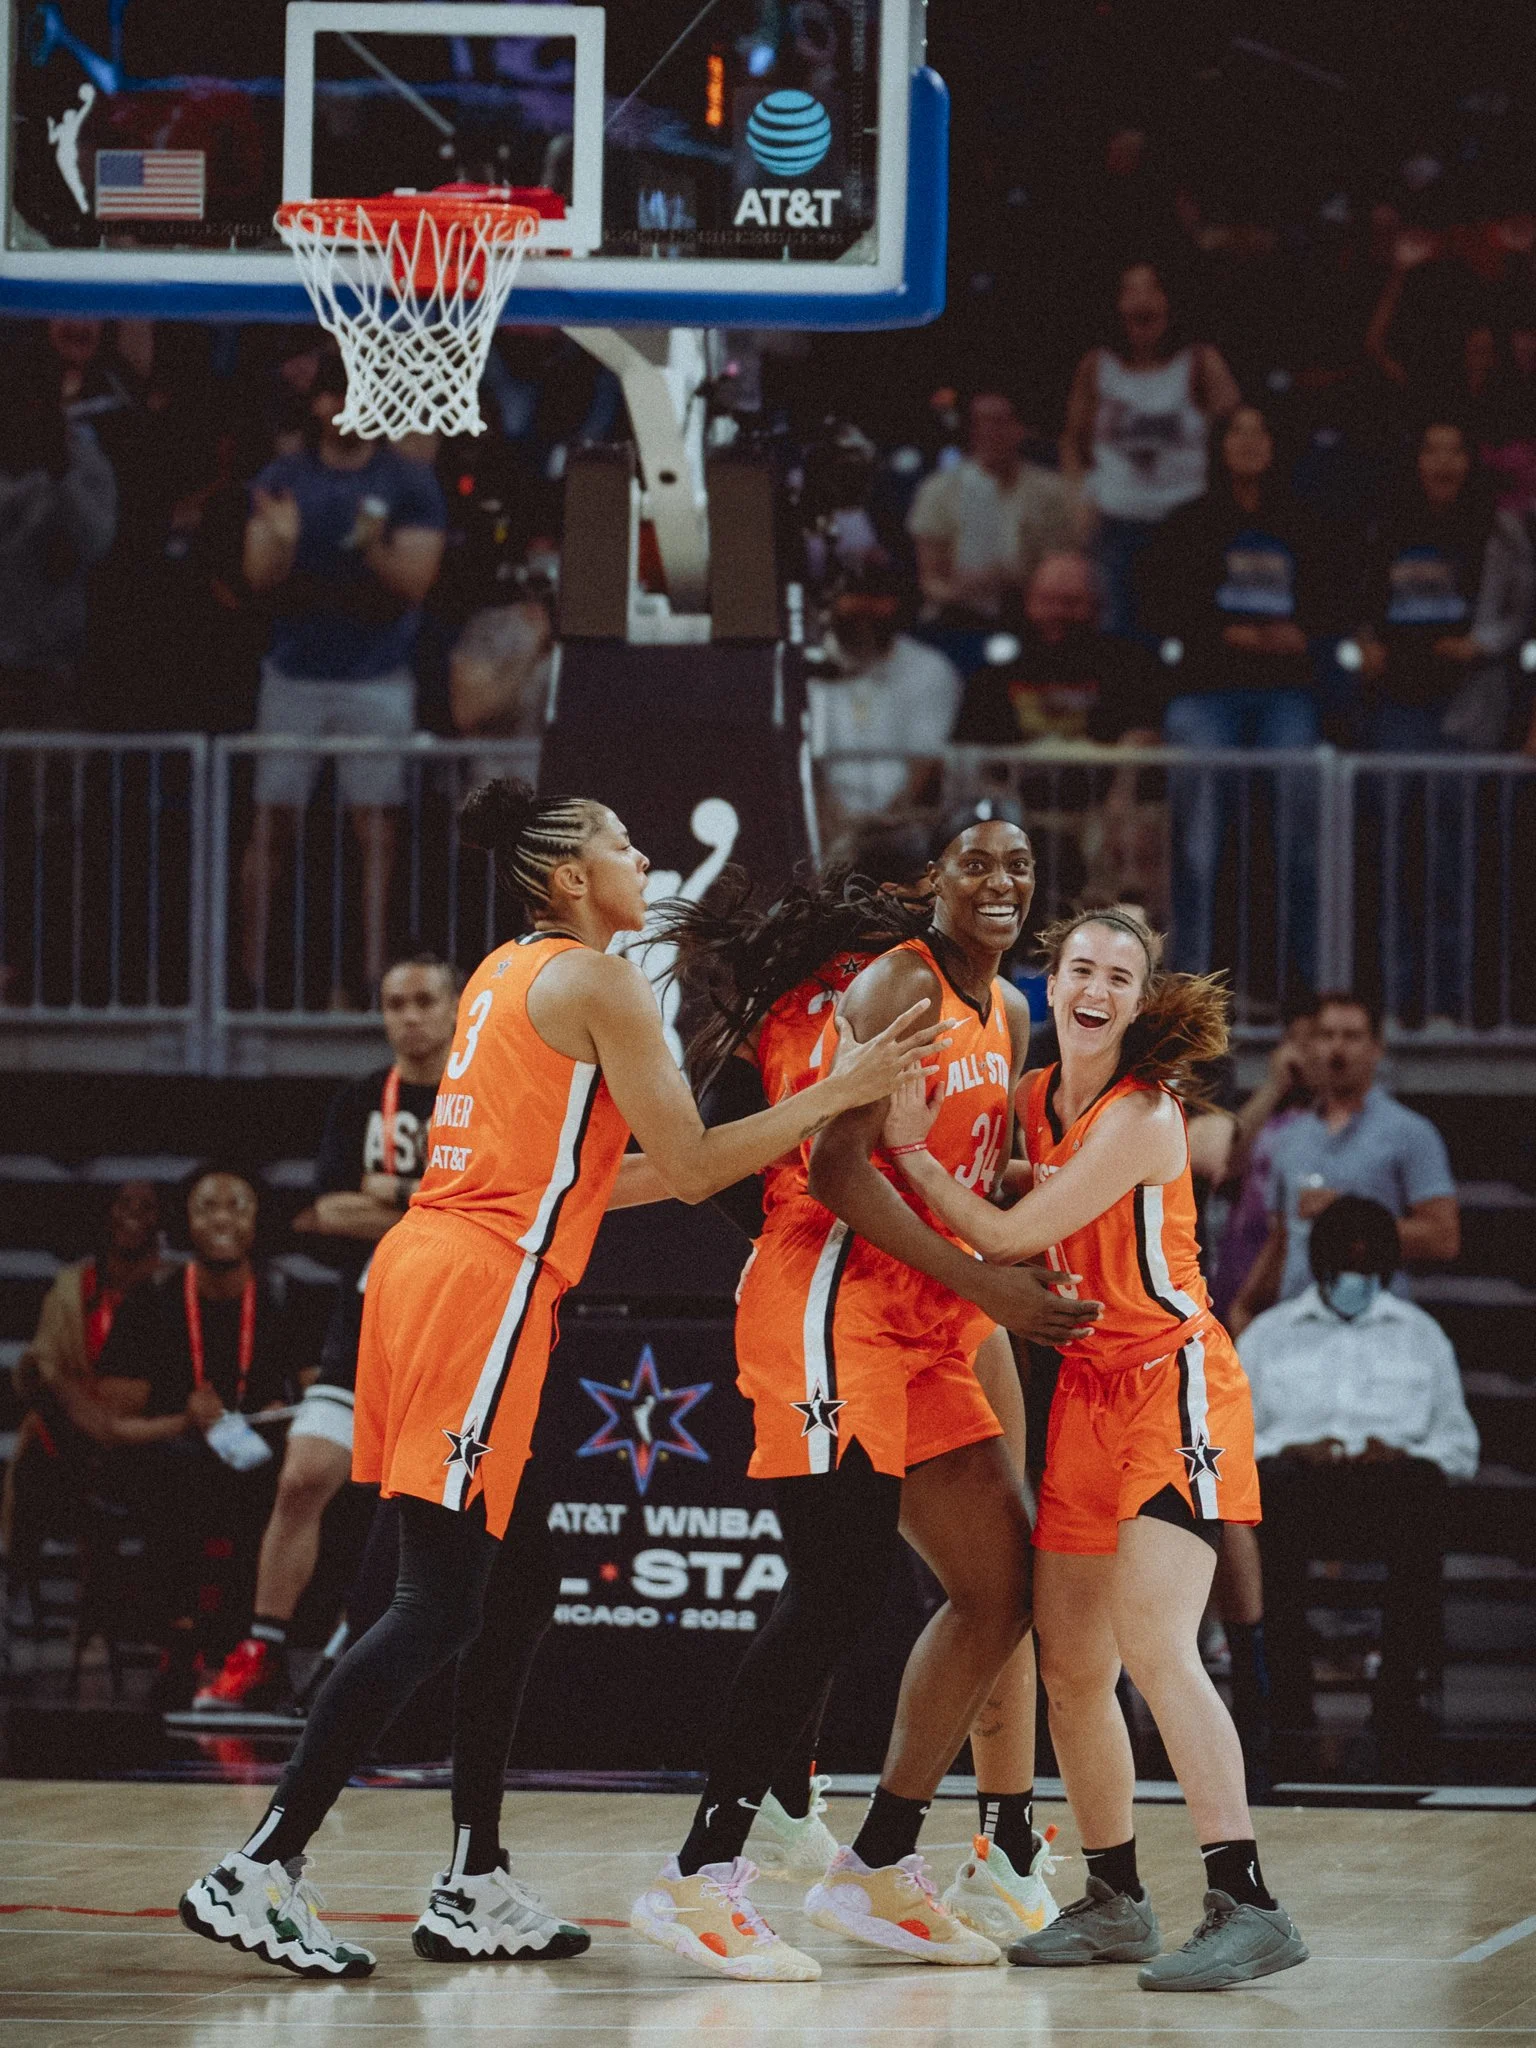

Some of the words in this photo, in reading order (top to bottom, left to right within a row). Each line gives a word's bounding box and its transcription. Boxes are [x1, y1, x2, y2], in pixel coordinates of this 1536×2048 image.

[733, 187, 842, 228] AT&T
[447, 989, 493, 1080] 3
[945, 1053, 984, 1097] ALL
[363, 1110, 431, 1173] AS
[430, 1145, 473, 1172] AT&T
[954, 1112, 1003, 1193] 34
[548, 1502, 627, 1534] AT&T
[643, 1505, 783, 1541] WNBA
[631, 1549, 789, 1600] STA
[680, 1607, 757, 1631] 2022
